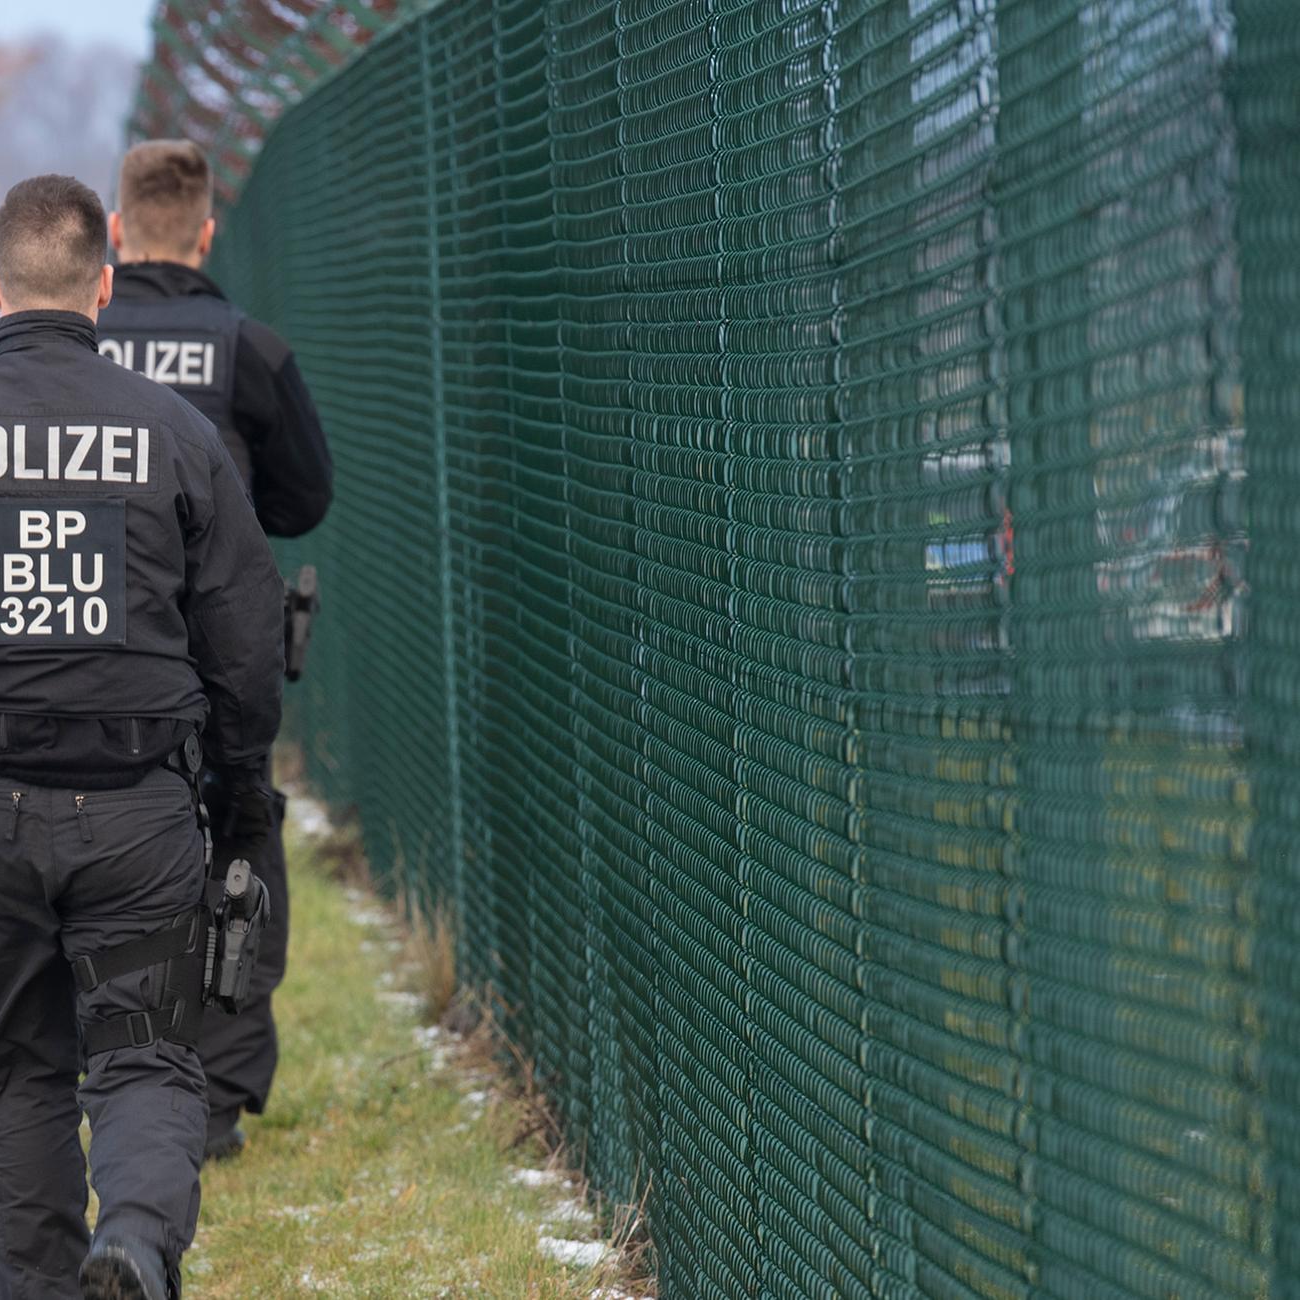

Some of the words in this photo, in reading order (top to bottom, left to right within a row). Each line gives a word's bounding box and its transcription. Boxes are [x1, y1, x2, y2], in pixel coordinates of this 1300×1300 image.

[97, 338, 215, 385] OLIZEI
[19, 509, 87, 550] BP
[3, 552, 104, 593] BLU
[0, 595, 108, 636] 3210
